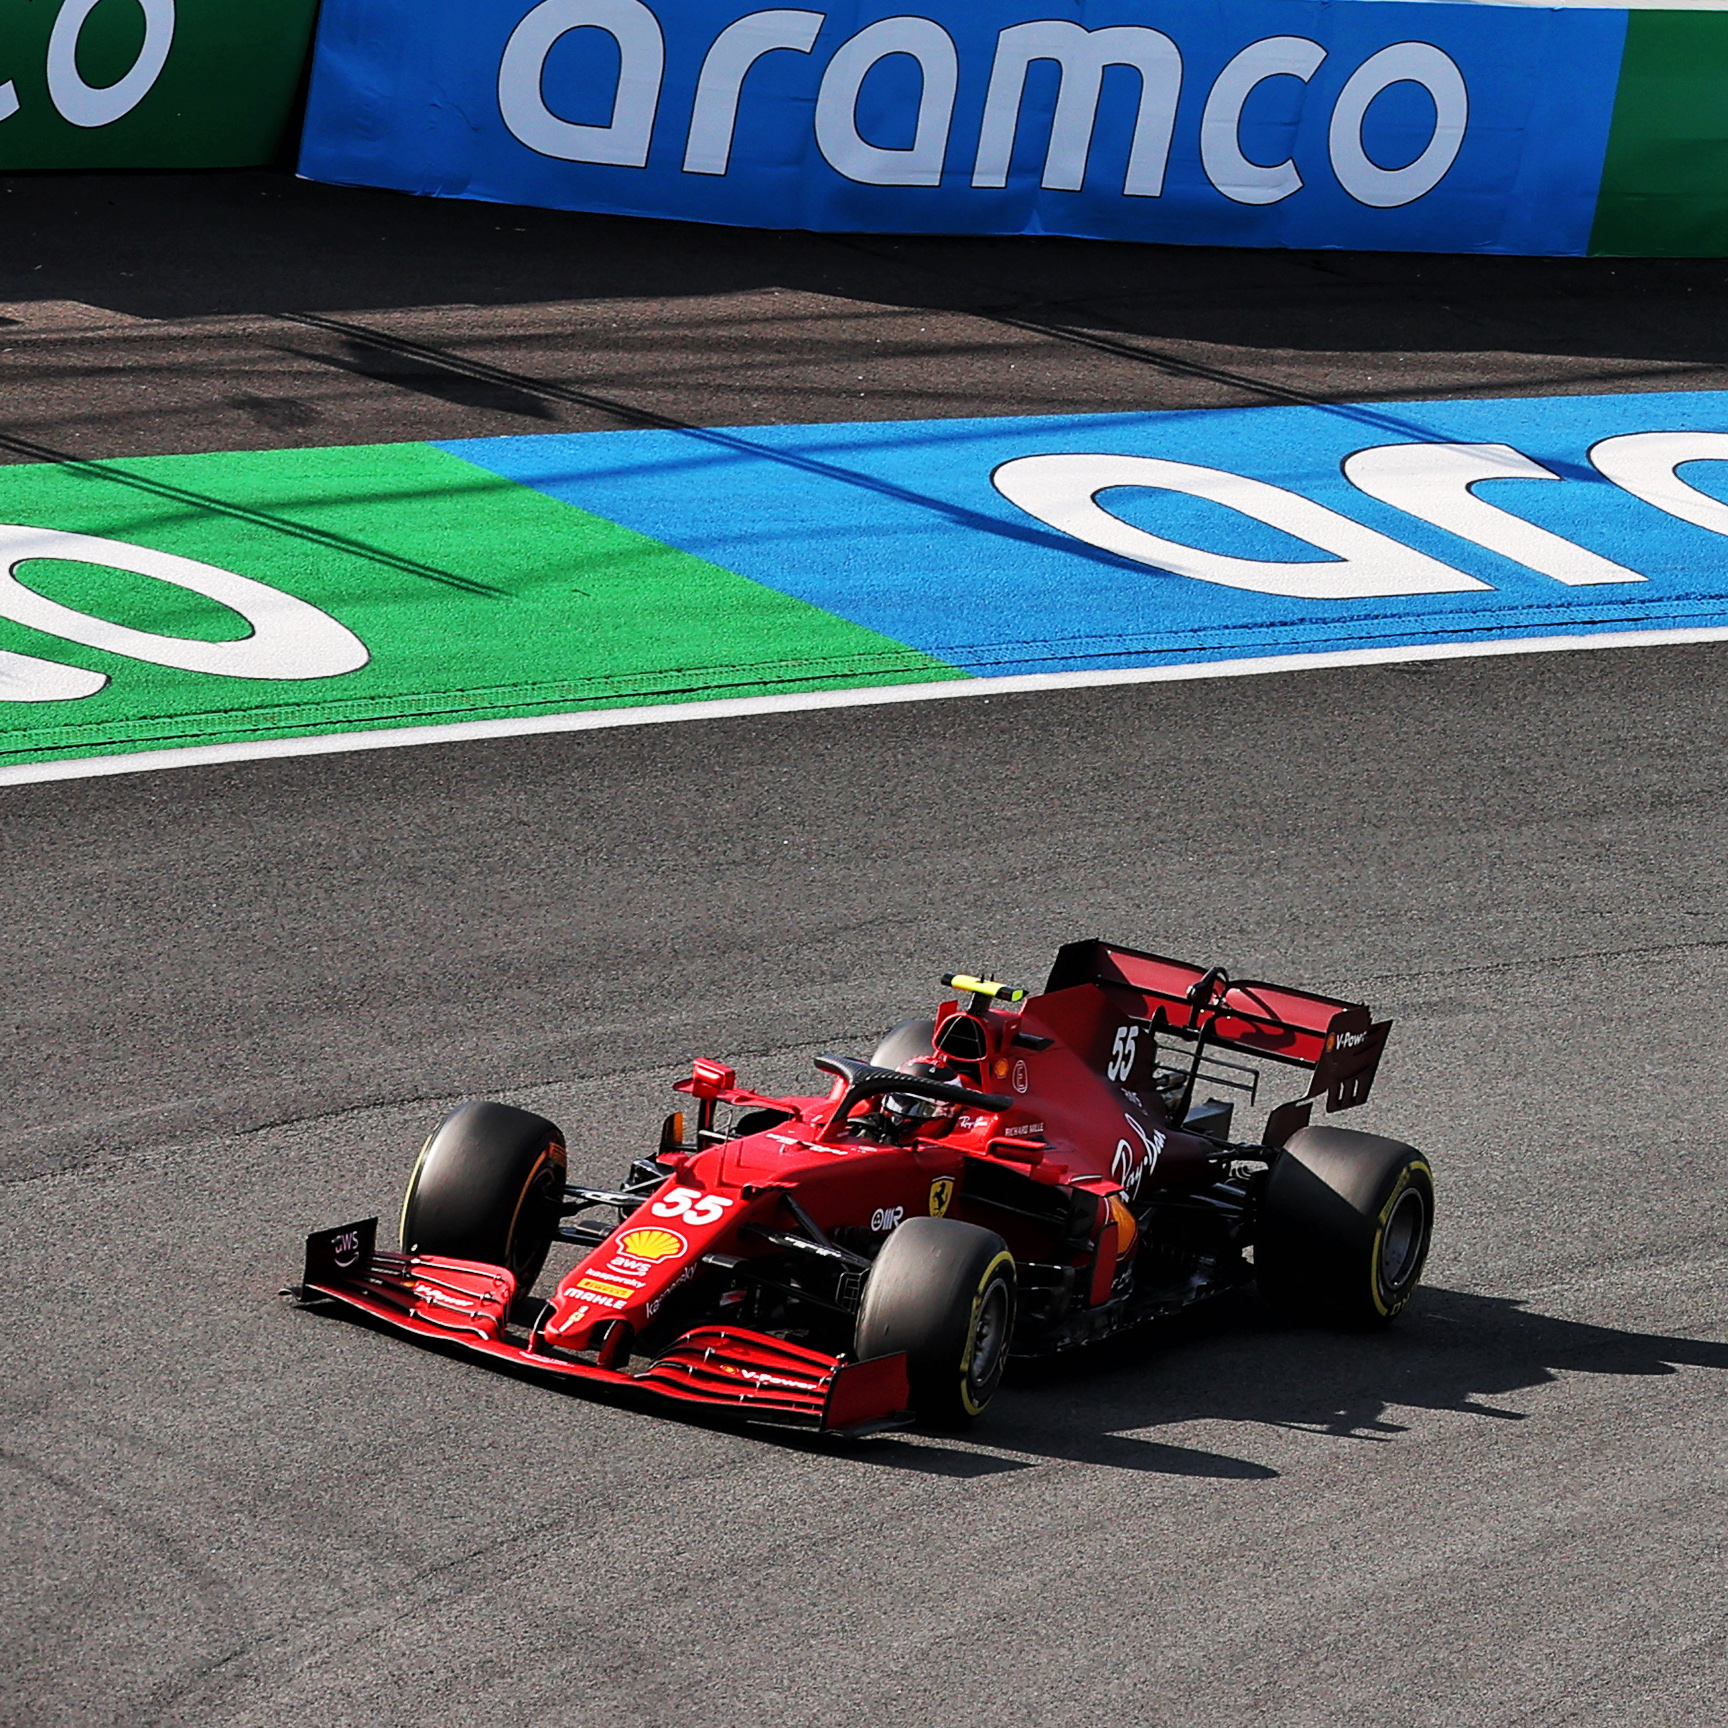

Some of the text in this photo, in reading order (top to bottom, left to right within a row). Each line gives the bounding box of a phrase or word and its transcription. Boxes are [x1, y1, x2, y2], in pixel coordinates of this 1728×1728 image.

[1107, 1025, 1140, 1082] 55
[651, 1187, 734, 1226] 55
[610, 1256, 652, 1273] aws
[585, 1267, 647, 1289] kaspersky
[563, 1287, 628, 1310] MAHLE
[741, 1369, 818, 1390] V-Power
